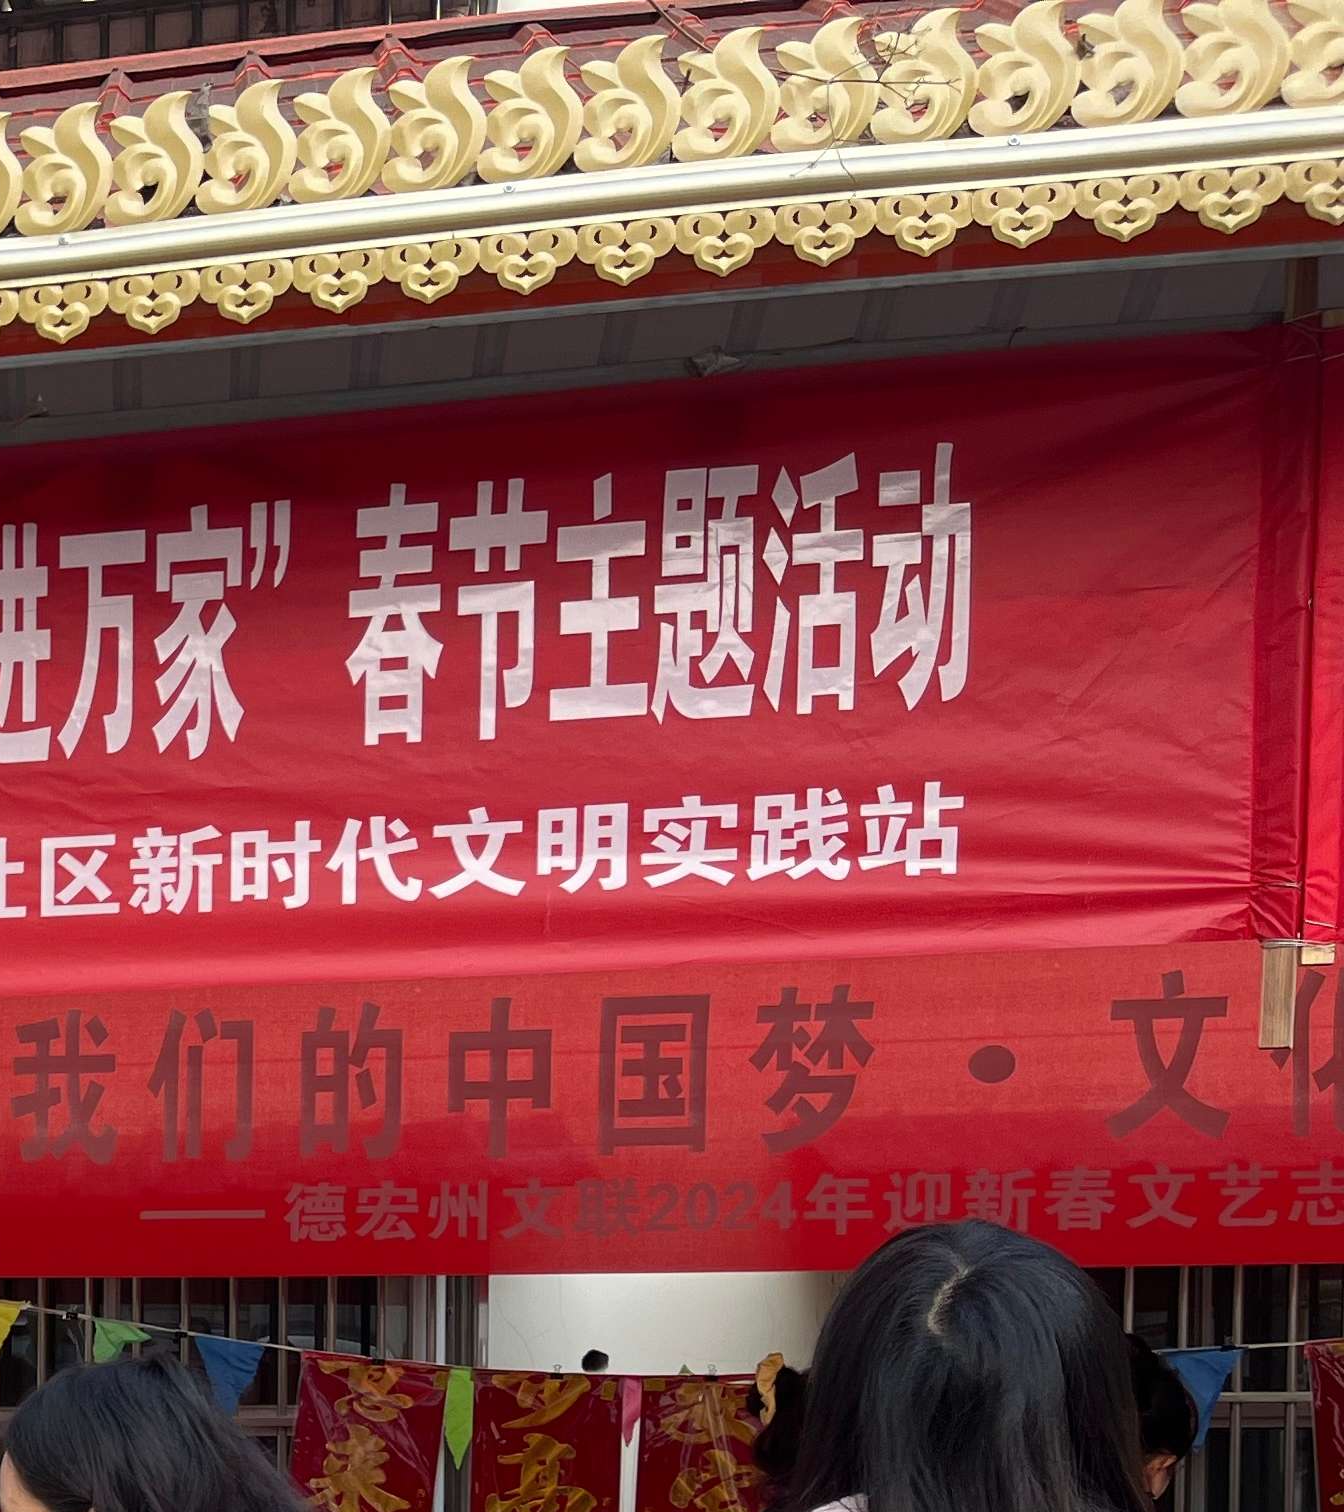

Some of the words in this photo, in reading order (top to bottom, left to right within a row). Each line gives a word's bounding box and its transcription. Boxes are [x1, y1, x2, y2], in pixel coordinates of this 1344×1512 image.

[344, 441, 974, 748] 春节主题活动
